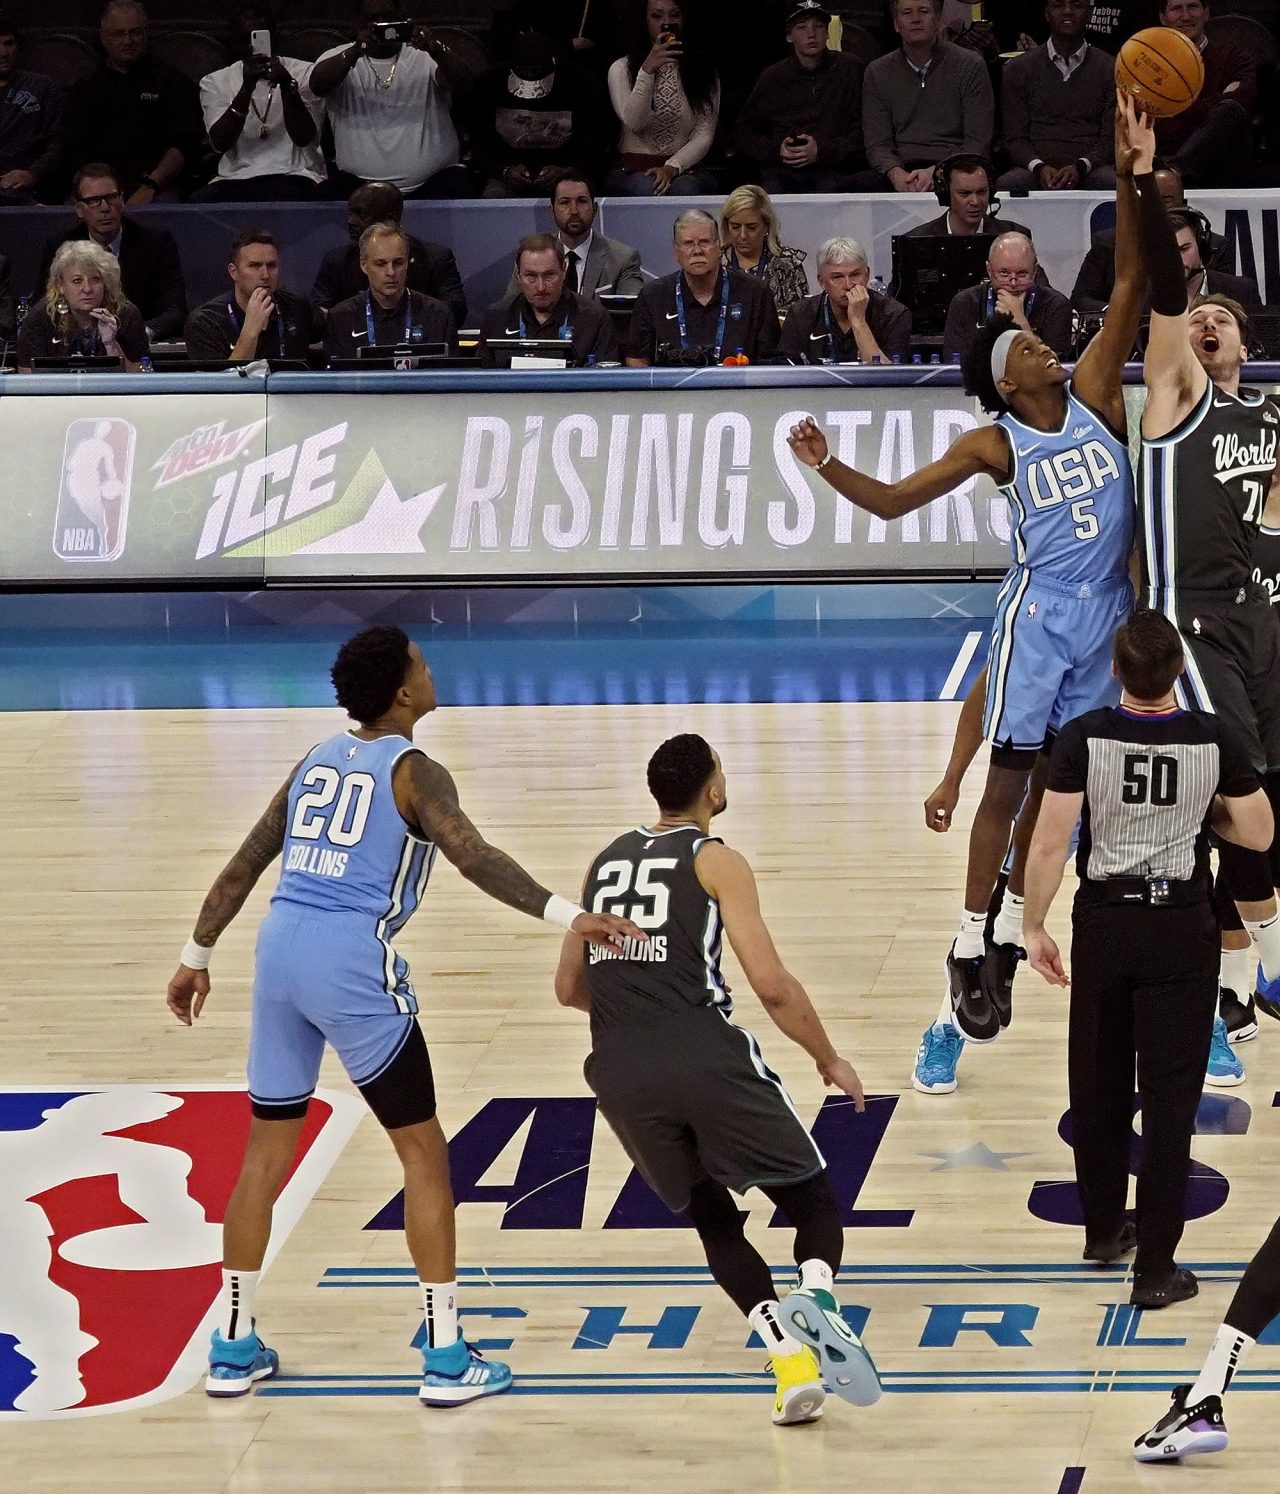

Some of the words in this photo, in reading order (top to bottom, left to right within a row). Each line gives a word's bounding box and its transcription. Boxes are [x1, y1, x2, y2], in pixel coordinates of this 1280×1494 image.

[1026, 440, 1121, 509] USA
[1212, 428, 1277, 476] World
[63, 528, 95, 551] NBA
[1071, 498, 1100, 540] 5
[1122, 753, 1178, 807] 50
[290, 764, 376, 848] 20
[285, 845, 349, 878] COLLINS
[592, 857, 678, 929] 25
